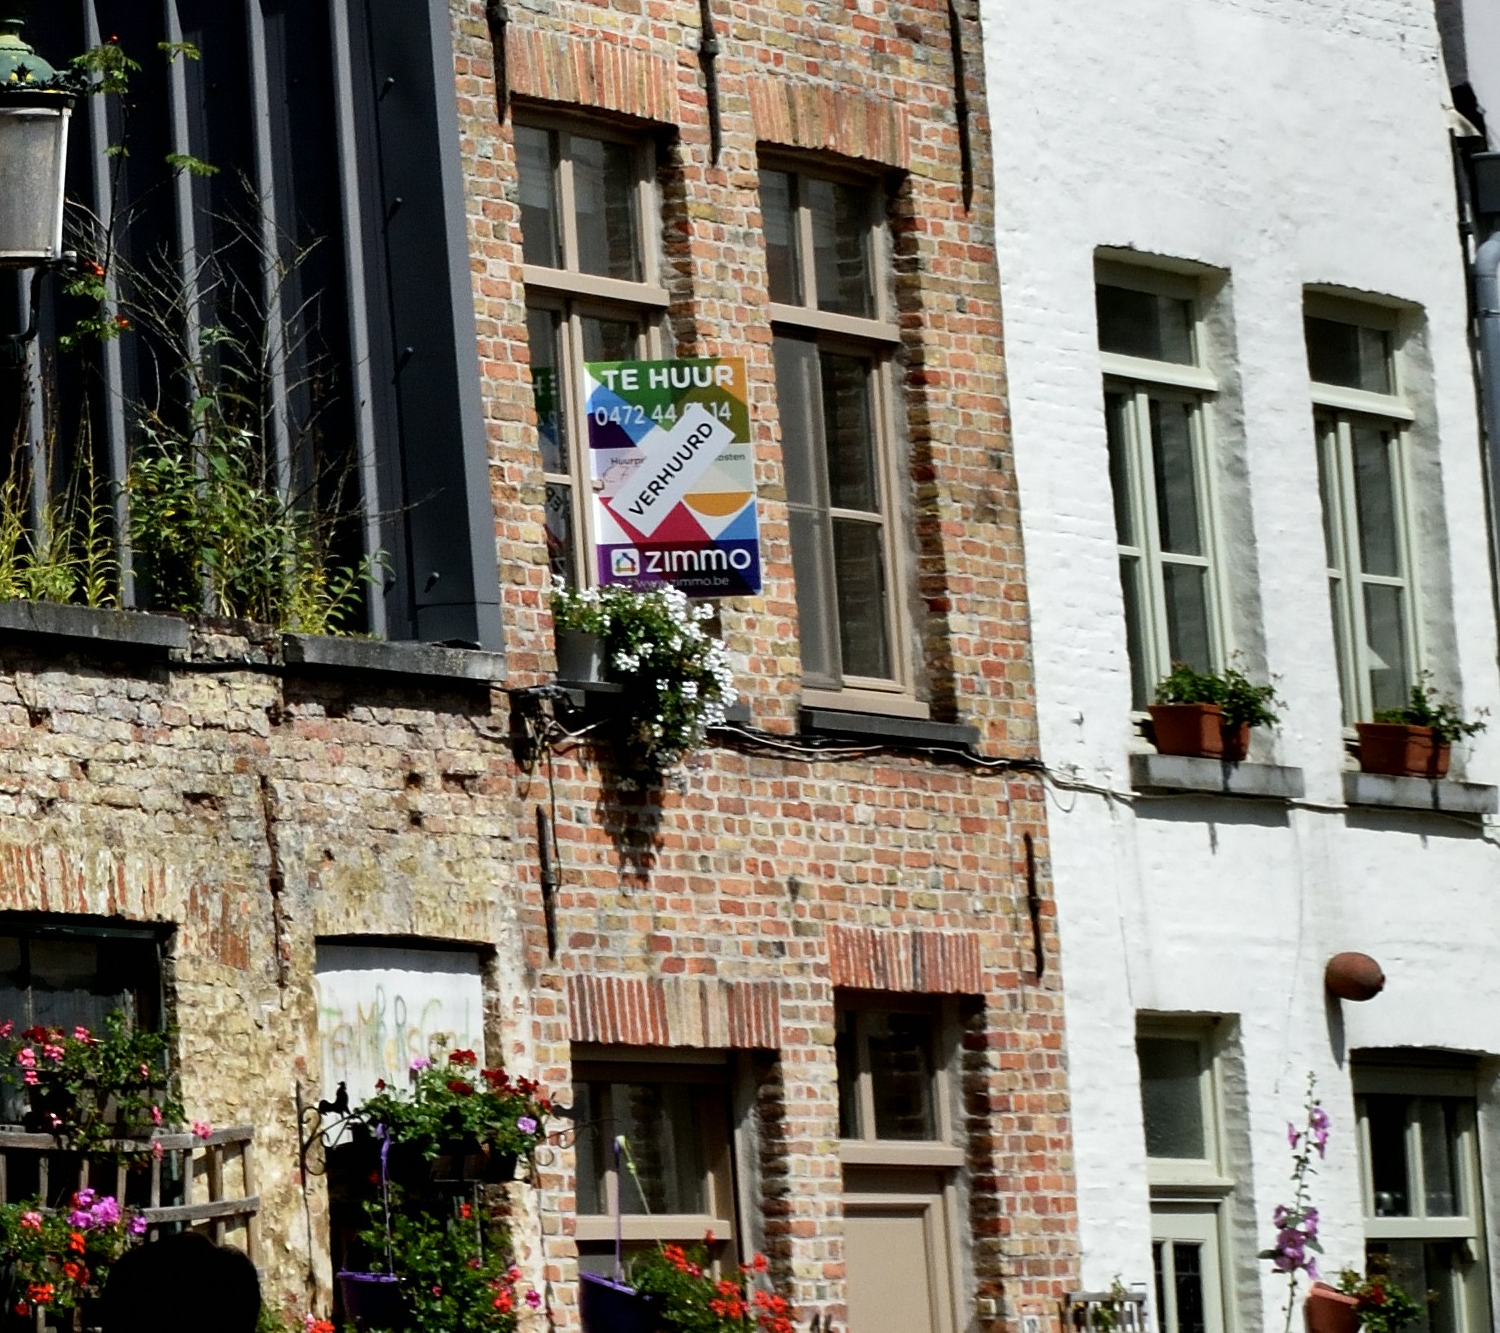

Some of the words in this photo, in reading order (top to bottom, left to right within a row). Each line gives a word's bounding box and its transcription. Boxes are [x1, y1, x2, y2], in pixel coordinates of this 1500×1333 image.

[601, 368, 640, 391] TE
[649, 364, 734, 390] HUUR
[595, 404, 646, 427] 0472
[651, 403, 678, 423] 44
[628, 422, 714, 516] VERHUURD
[715, 453, 746, 462] osten
